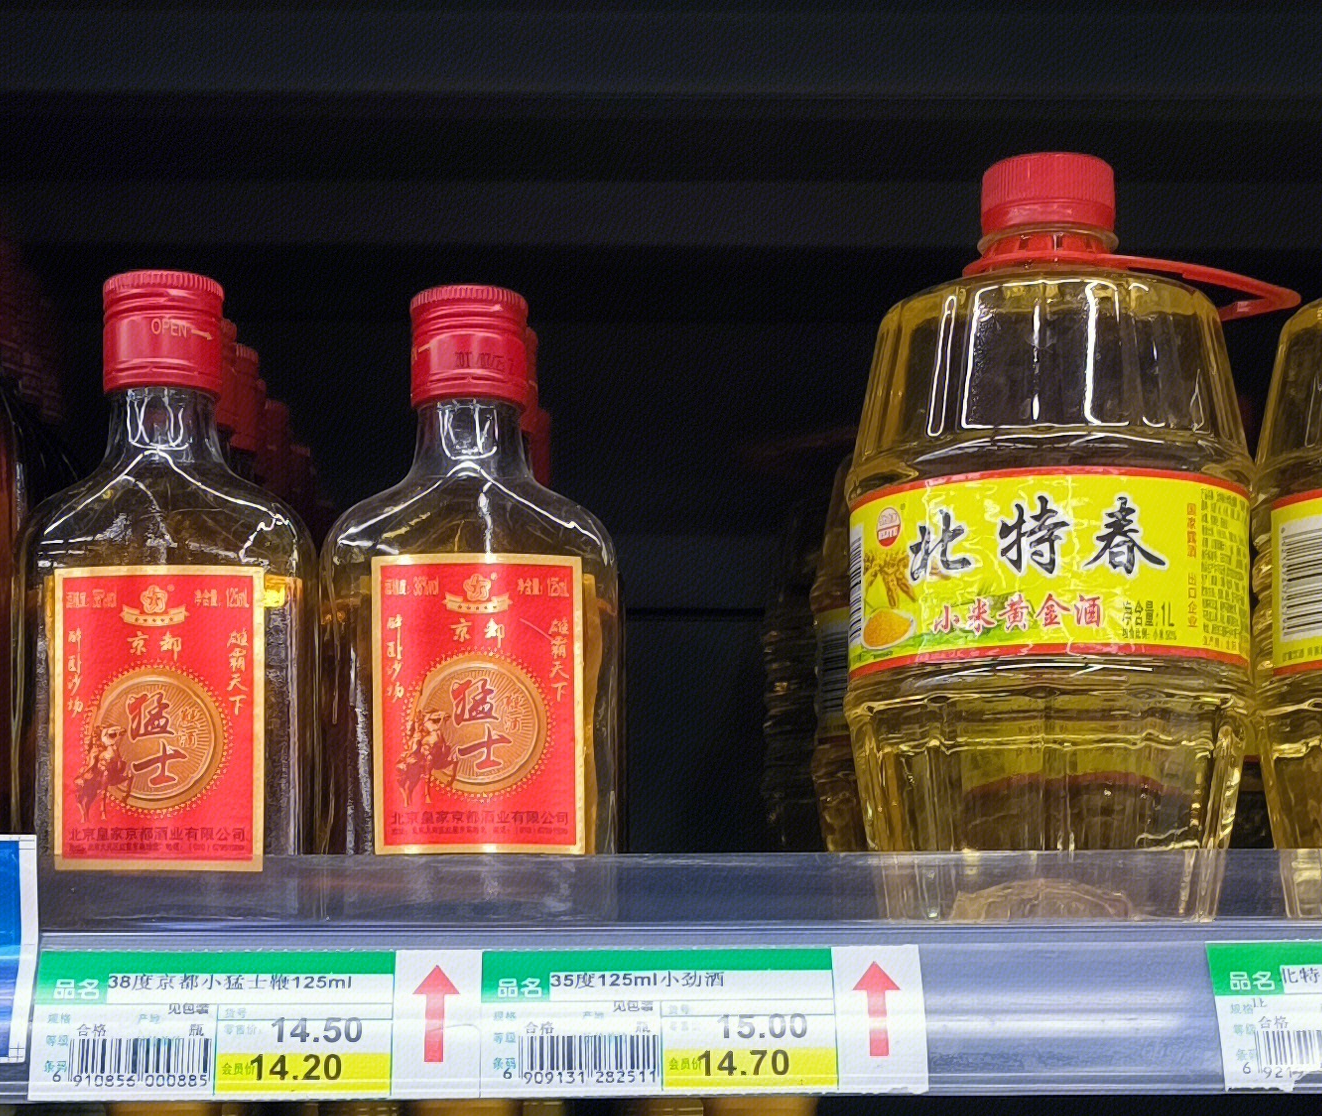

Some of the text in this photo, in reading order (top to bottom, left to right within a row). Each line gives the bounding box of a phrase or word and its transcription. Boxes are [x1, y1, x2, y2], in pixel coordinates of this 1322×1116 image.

[150, 317, 189, 338] OPEN
[908, 495, 1166, 583] 北特春
[932, 594, 1102, 634] 小米黄金酒
[127, 630, 182, 660] 京都
[450, 618, 506, 649] 京都
[450, 677, 513, 771] 猛士
[126, 690, 188, 787] 猛士
[53, 979, 100, 1000] 品名
[497, 971, 725, 998] 品名 35度125ml小劲酒
[1229, 971, 1275, 991] 品名
[76, 1024, 107, 1037] 合格
[271, 1017, 364, 1044] 14.50
[717, 1013, 809, 1039] 15.00
[251, 1053, 343, 1081] 14.20
[698, 1049, 791, 1078] 14.70
[144, 1073, 208, 1087] 000885
[524, 1070, 657, 1085] 909131 282511
